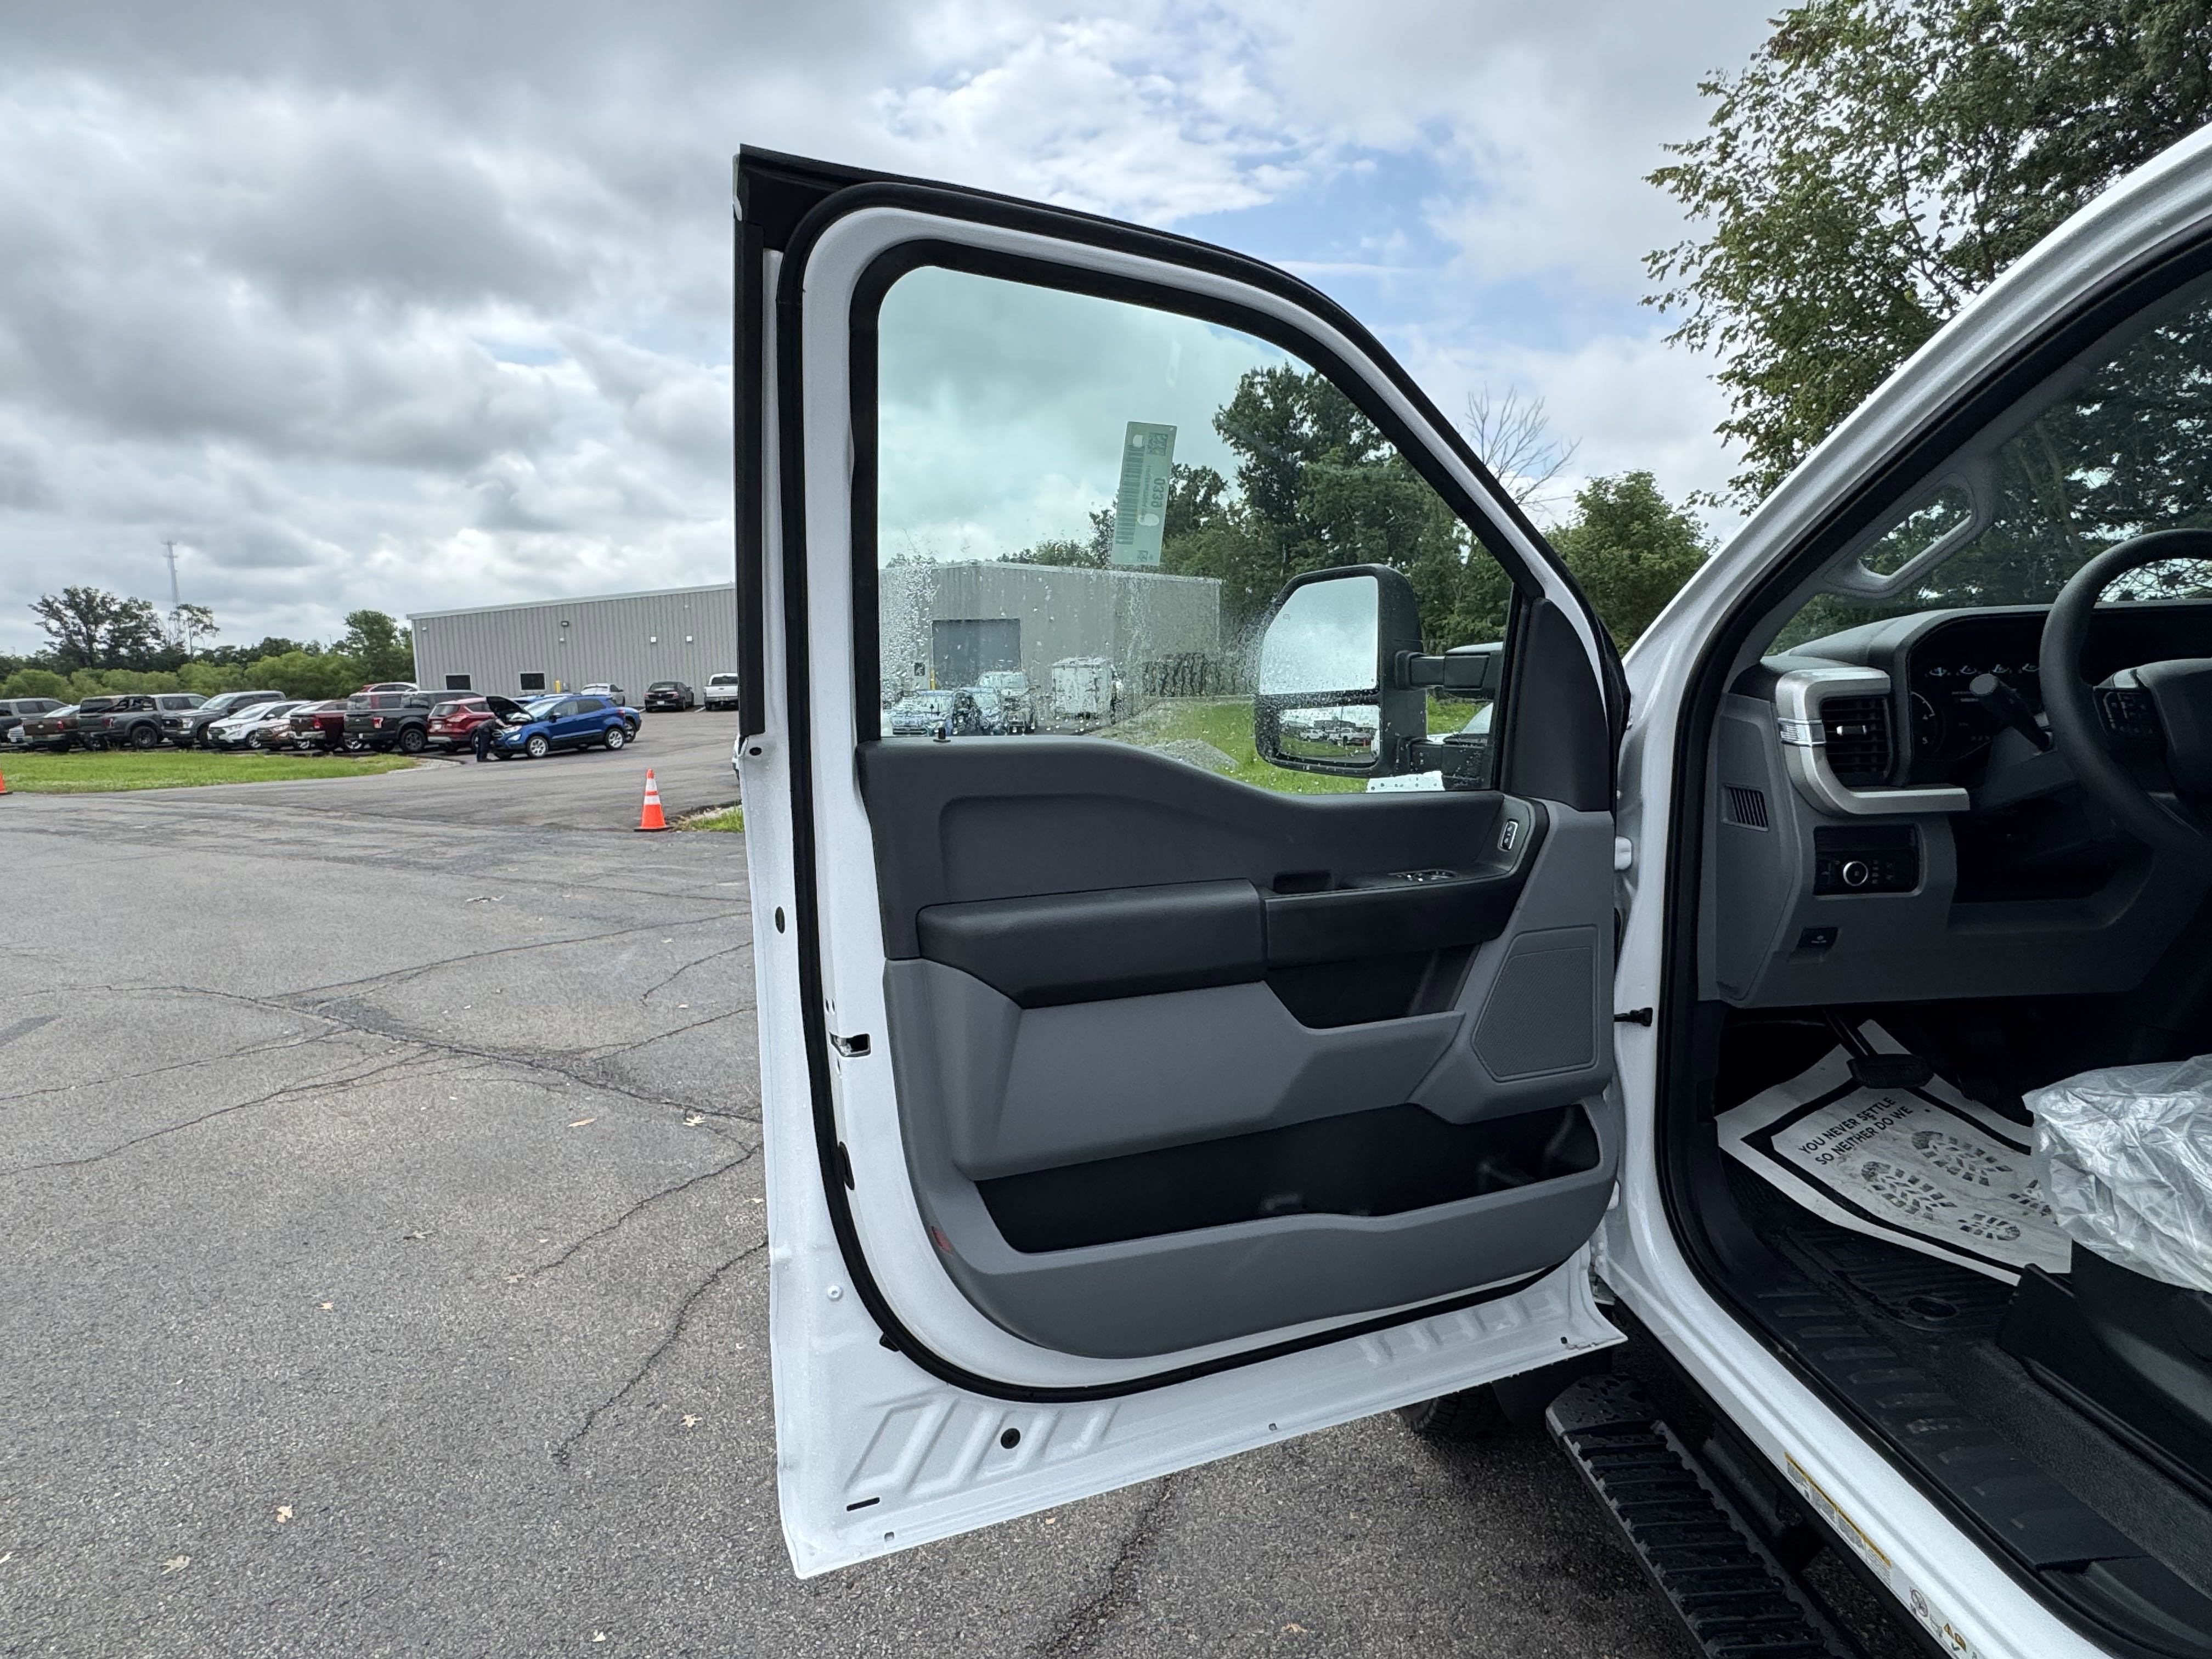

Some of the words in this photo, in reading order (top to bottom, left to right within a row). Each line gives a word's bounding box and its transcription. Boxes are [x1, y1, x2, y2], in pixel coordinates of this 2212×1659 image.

[1798, 1136, 1826, 1154] YOU
[1821, 1118, 1860, 1140] NEVER
[1856, 1097, 1897, 1121] SETTLE
[1815, 1152, 1835, 1165] SO
[1831, 1126, 1879, 1155] NEITHER
[1874, 1117, 1894, 1130] DO
[1889, 1106, 1914, 1119] WE
